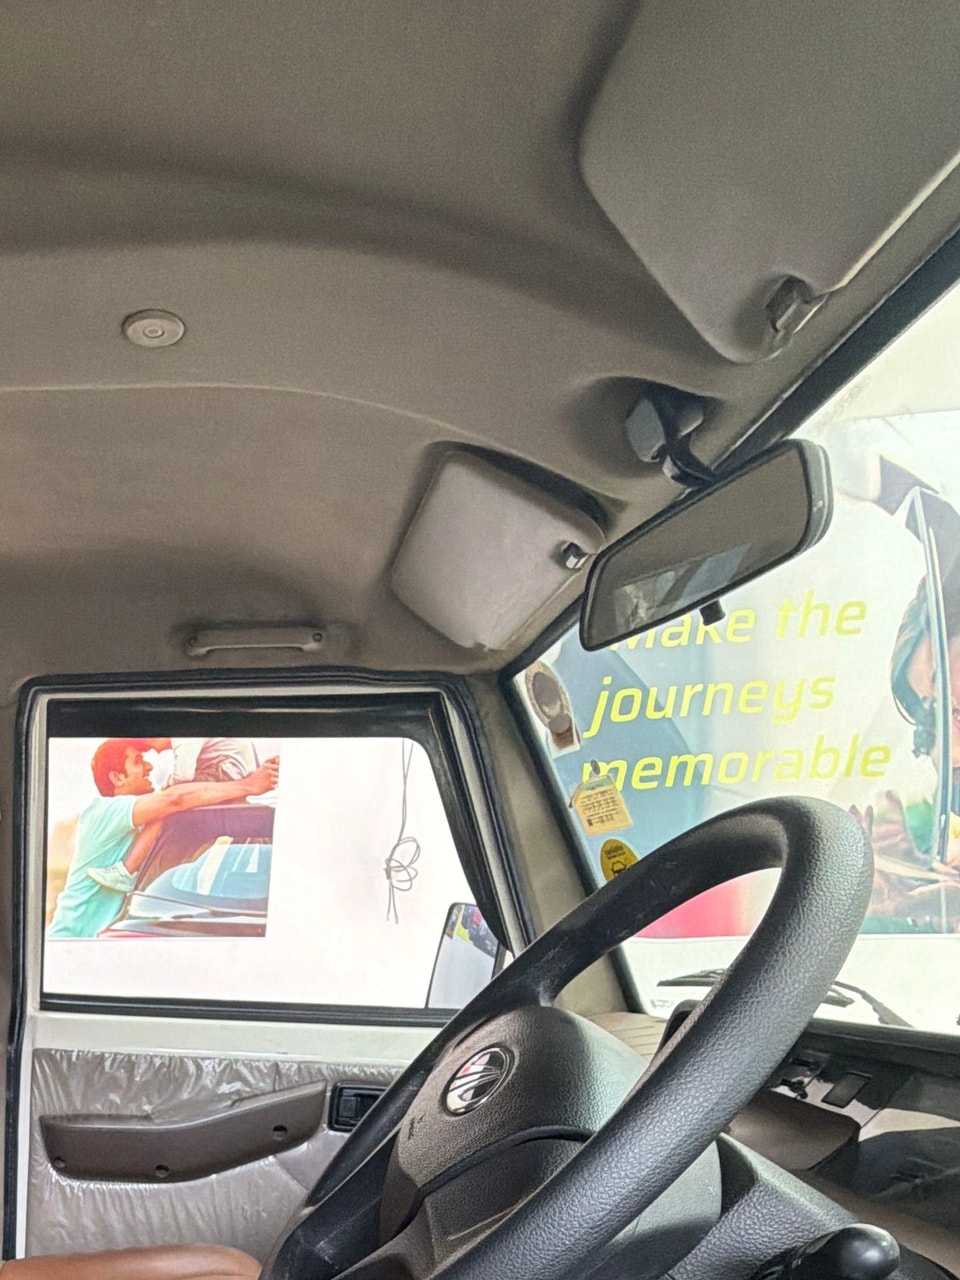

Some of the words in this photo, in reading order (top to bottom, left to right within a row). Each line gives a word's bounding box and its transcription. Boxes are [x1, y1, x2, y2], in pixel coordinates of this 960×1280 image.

[776, 590, 868, 638] the
[582, 676, 836, 739] journeys
[581, 734, 892, 791] memorable
